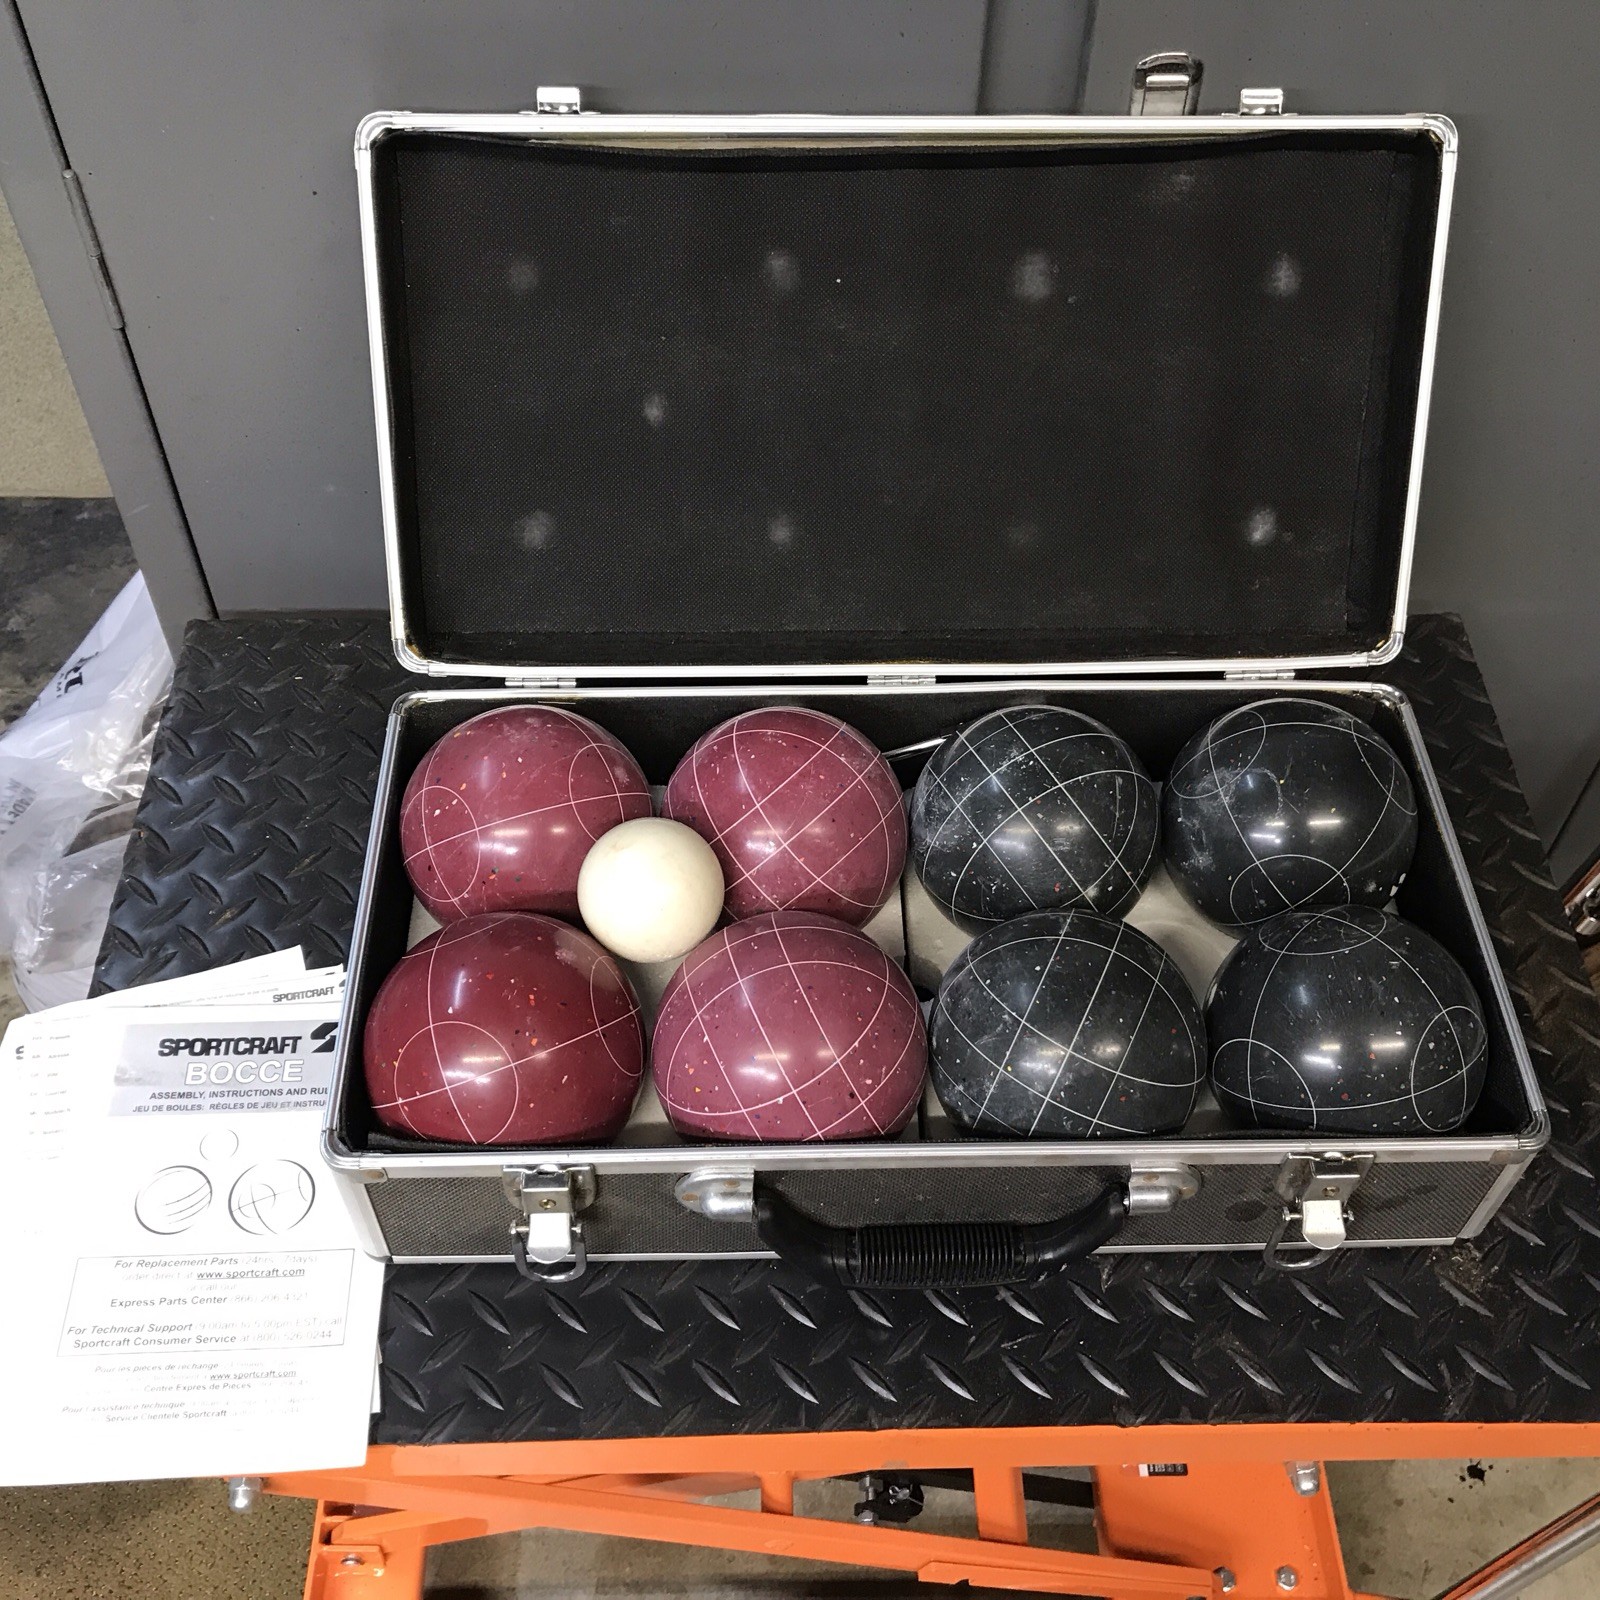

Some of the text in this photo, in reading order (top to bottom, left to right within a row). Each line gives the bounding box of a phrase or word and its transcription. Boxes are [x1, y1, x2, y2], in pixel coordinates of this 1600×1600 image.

[272, 985, 335, 1004] SPORTCRAFT
[158, 1036, 302, 1057] SPORTCRAFT
[184, 1059, 305, 1085] BOCCE
[149, 1090, 206, 1100] ASSEMBLY,
[209, 1088, 284, 1098] INSTRUCTIONS
[286, 1087, 308, 1096] AND
[133, 1103, 149, 1112] JEU
[152, 1104, 164, 1112] DE
[166, 1103, 204, 1111] BOULES:
[261, 1101, 277, 1109] JEU
[114, 1260, 133, 1269] For
[136, 1258, 207, 1268] Replacement
[210, 1257, 238, 1265] Parts
[197, 1267, 305, 1281] www.sportcraft.com
[110, 1297, 155, 1308] Express
[158, 1297, 188, 1306] Parts
[191, 1295, 227, 1304] Center
[67, 1326, 87, 1335] For
[90, 1324, 144, 1334] Technical
[147, 1323, 193, 1333] Support
[74, 1338, 131, 1350] Sportcraft
[134, 1336, 189, 1346] Consumer
[193, 1335, 236, 1344] Service
[210, 1369, 297, 1381] www.sportcraft.com
[182, 1410, 227, 1419] Sportcraft
